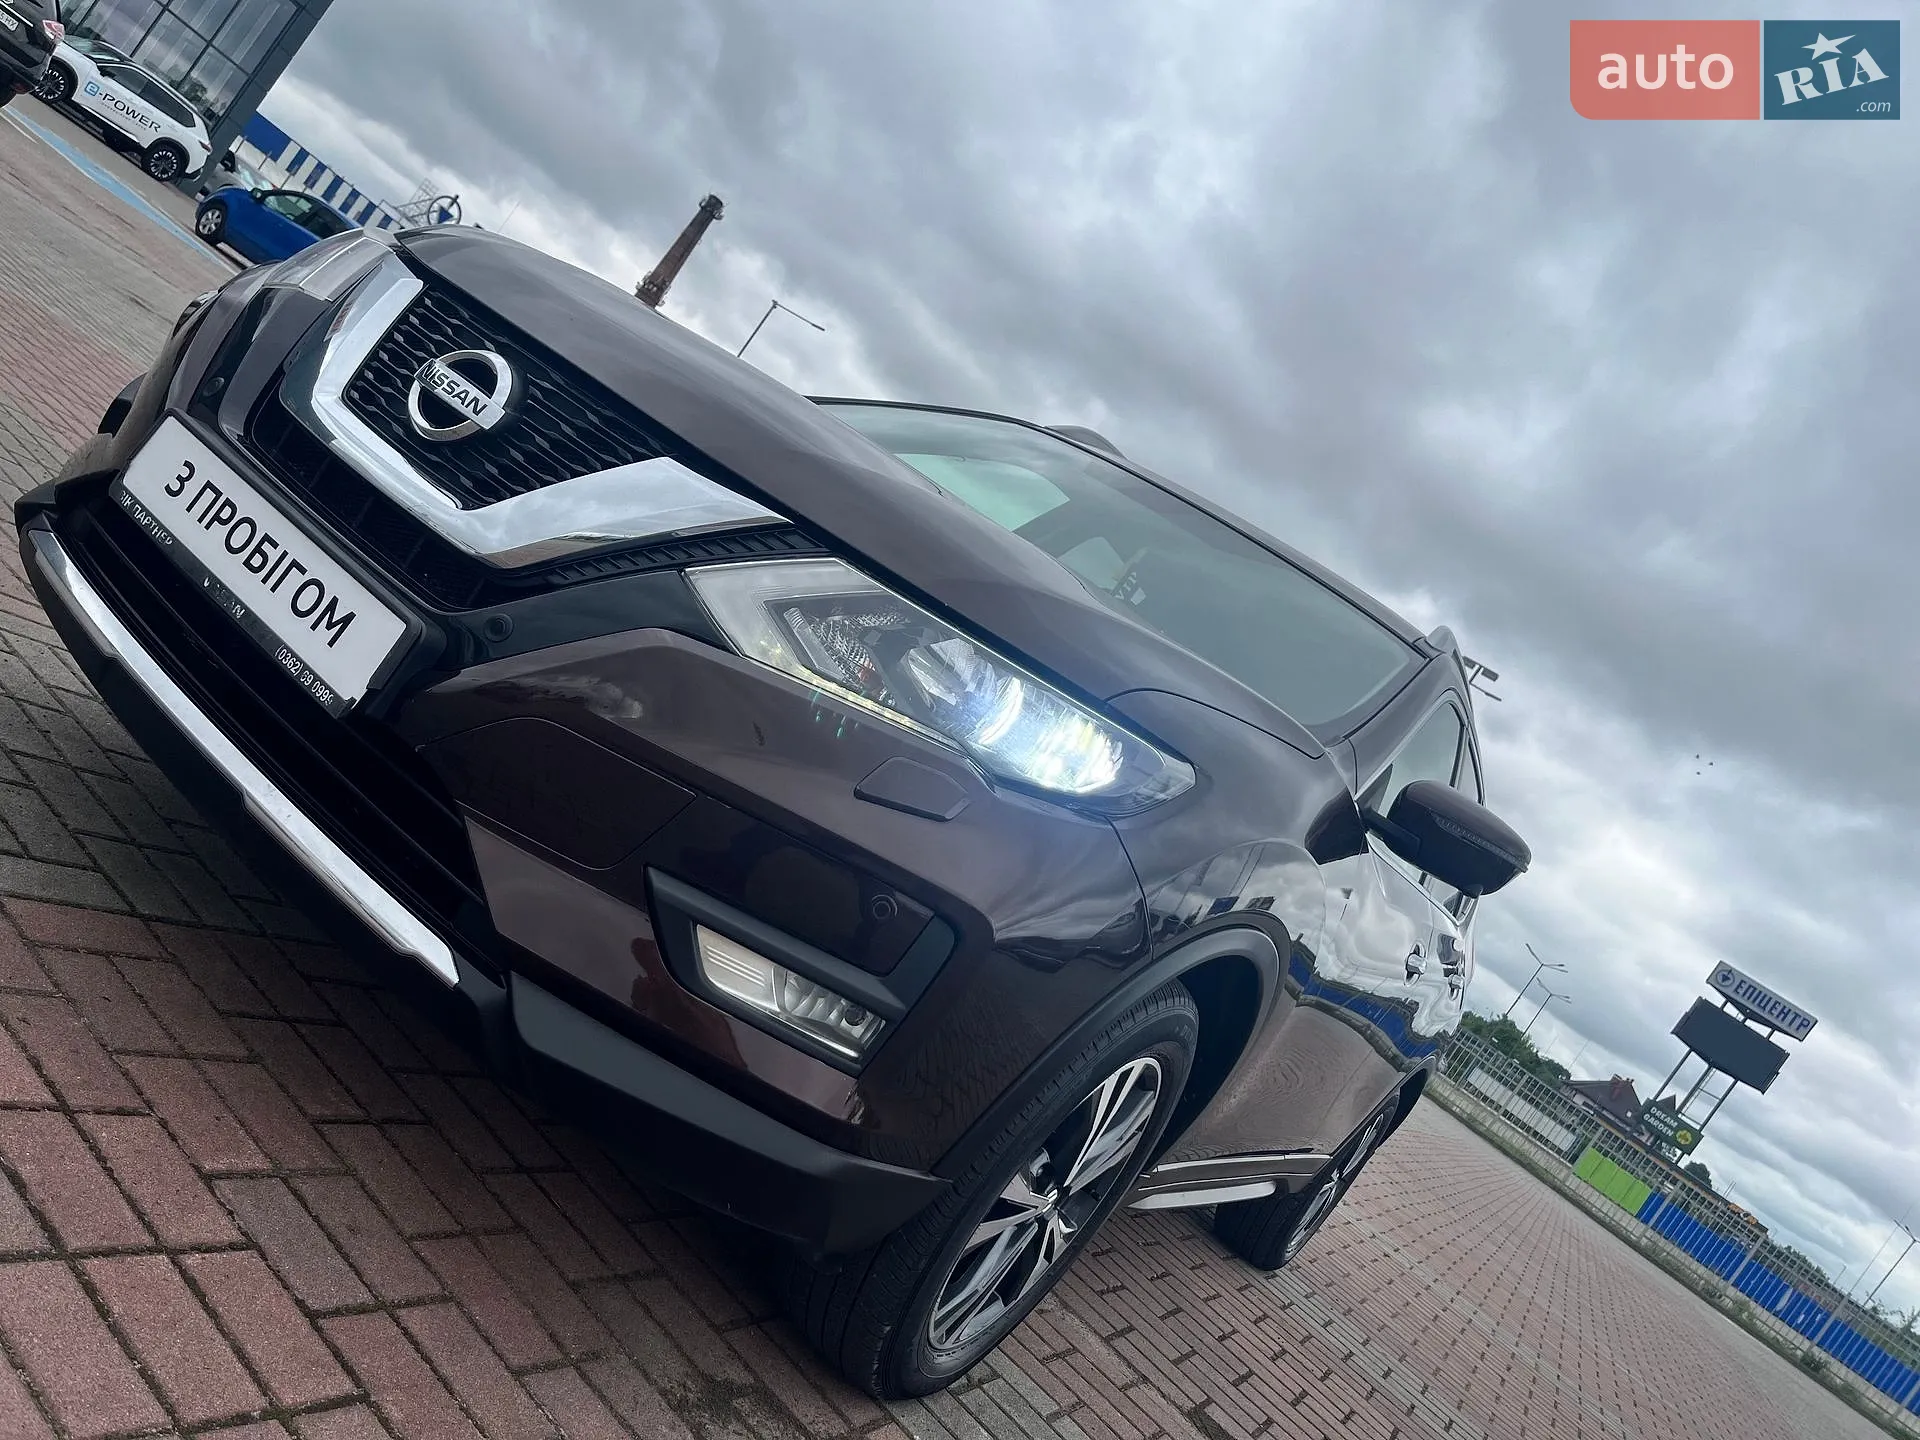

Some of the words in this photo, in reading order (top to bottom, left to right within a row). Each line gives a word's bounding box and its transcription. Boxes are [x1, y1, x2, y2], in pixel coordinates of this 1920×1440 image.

[420, 363, 488, 416] NISSAN
[185, 480, 357, 648] ПРОБІГОМ
[275, 644, 303, 676] (0362)
[1734, 980, 1811, 1032] ЕПІЦЕНТР
[1643, 1113, 1674, 1137] GARDEN
[1650, 1106, 1678, 1128] DREAM
